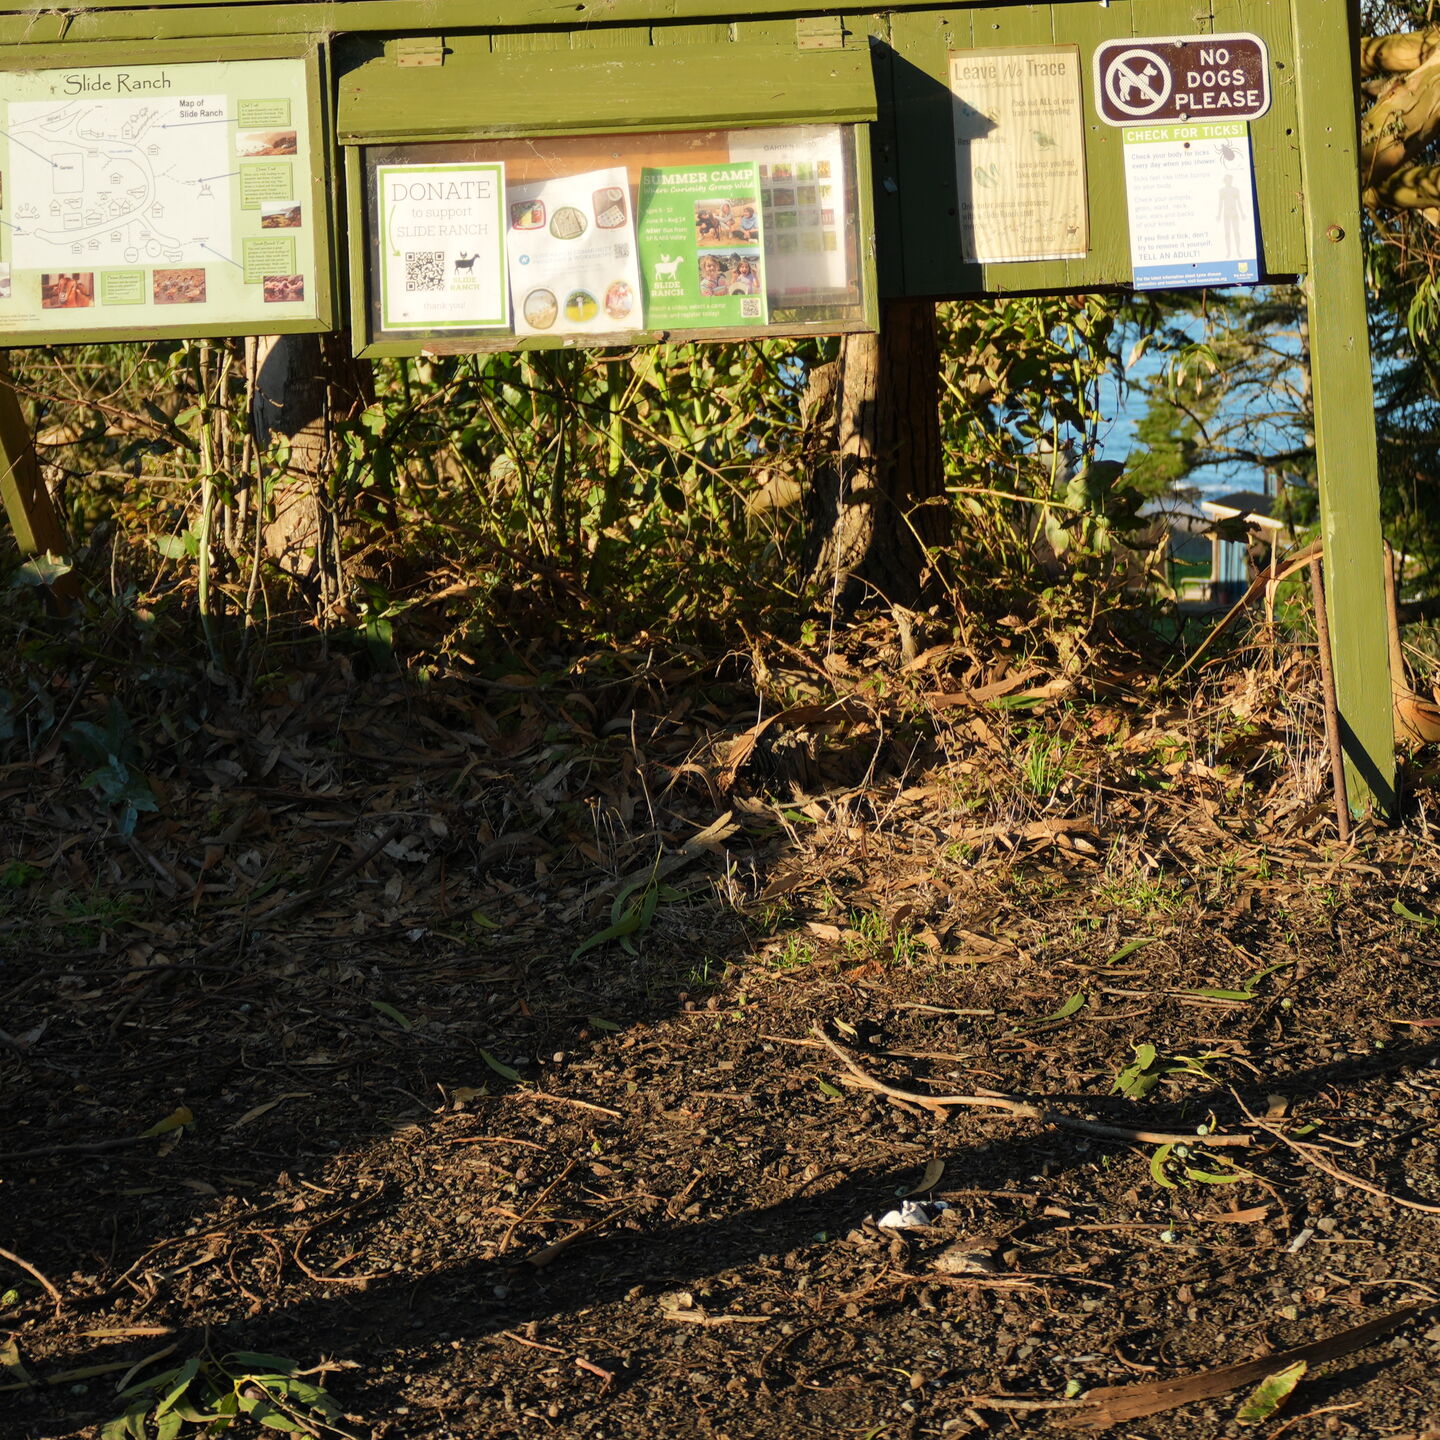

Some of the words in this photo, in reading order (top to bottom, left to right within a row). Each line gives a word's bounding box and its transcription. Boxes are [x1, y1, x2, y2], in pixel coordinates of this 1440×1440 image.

[1200, 48, 1229, 67] NO
[955, 63, 996, 80] Leave
[1004, 64, 1023, 80] No
[1026, 59, 1065, 76] Trace
[64, 73, 112, 95] Slide
[117, 71, 171, 94] Ranch
[1187, 69, 1245, 88] DOGS
[179, 100, 194, 108] Map
[197, 99, 204, 107] of
[1012, 98, 1026, 107] Pack
[1062, 98, 1074, 106] your
[1175, 90, 1259, 109] PLEASE
[180, 109, 198, 118] Slide
[200, 109, 223, 117] Ranch
[1127, 130, 1169, 141] CHECK
[1174, 128, 1197, 138] FOR
[1203, 125, 1244, 136] TICKS!
[643, 172, 708, 184] SUMMER
[711, 169, 753, 181] CAMP
[392, 181, 490, 201] DONATE
[412, 208, 423, 218] to
[426, 207, 472, 220] support
[397, 226, 436, 237] SLIDE
[439, 224, 488, 236] RANCH
[1139, 252, 1157, 260] TELL
[1173, 250, 1200, 258] ADULT!
[424, 302, 447, 310] thank
[449, 302, 465, 311] you!
